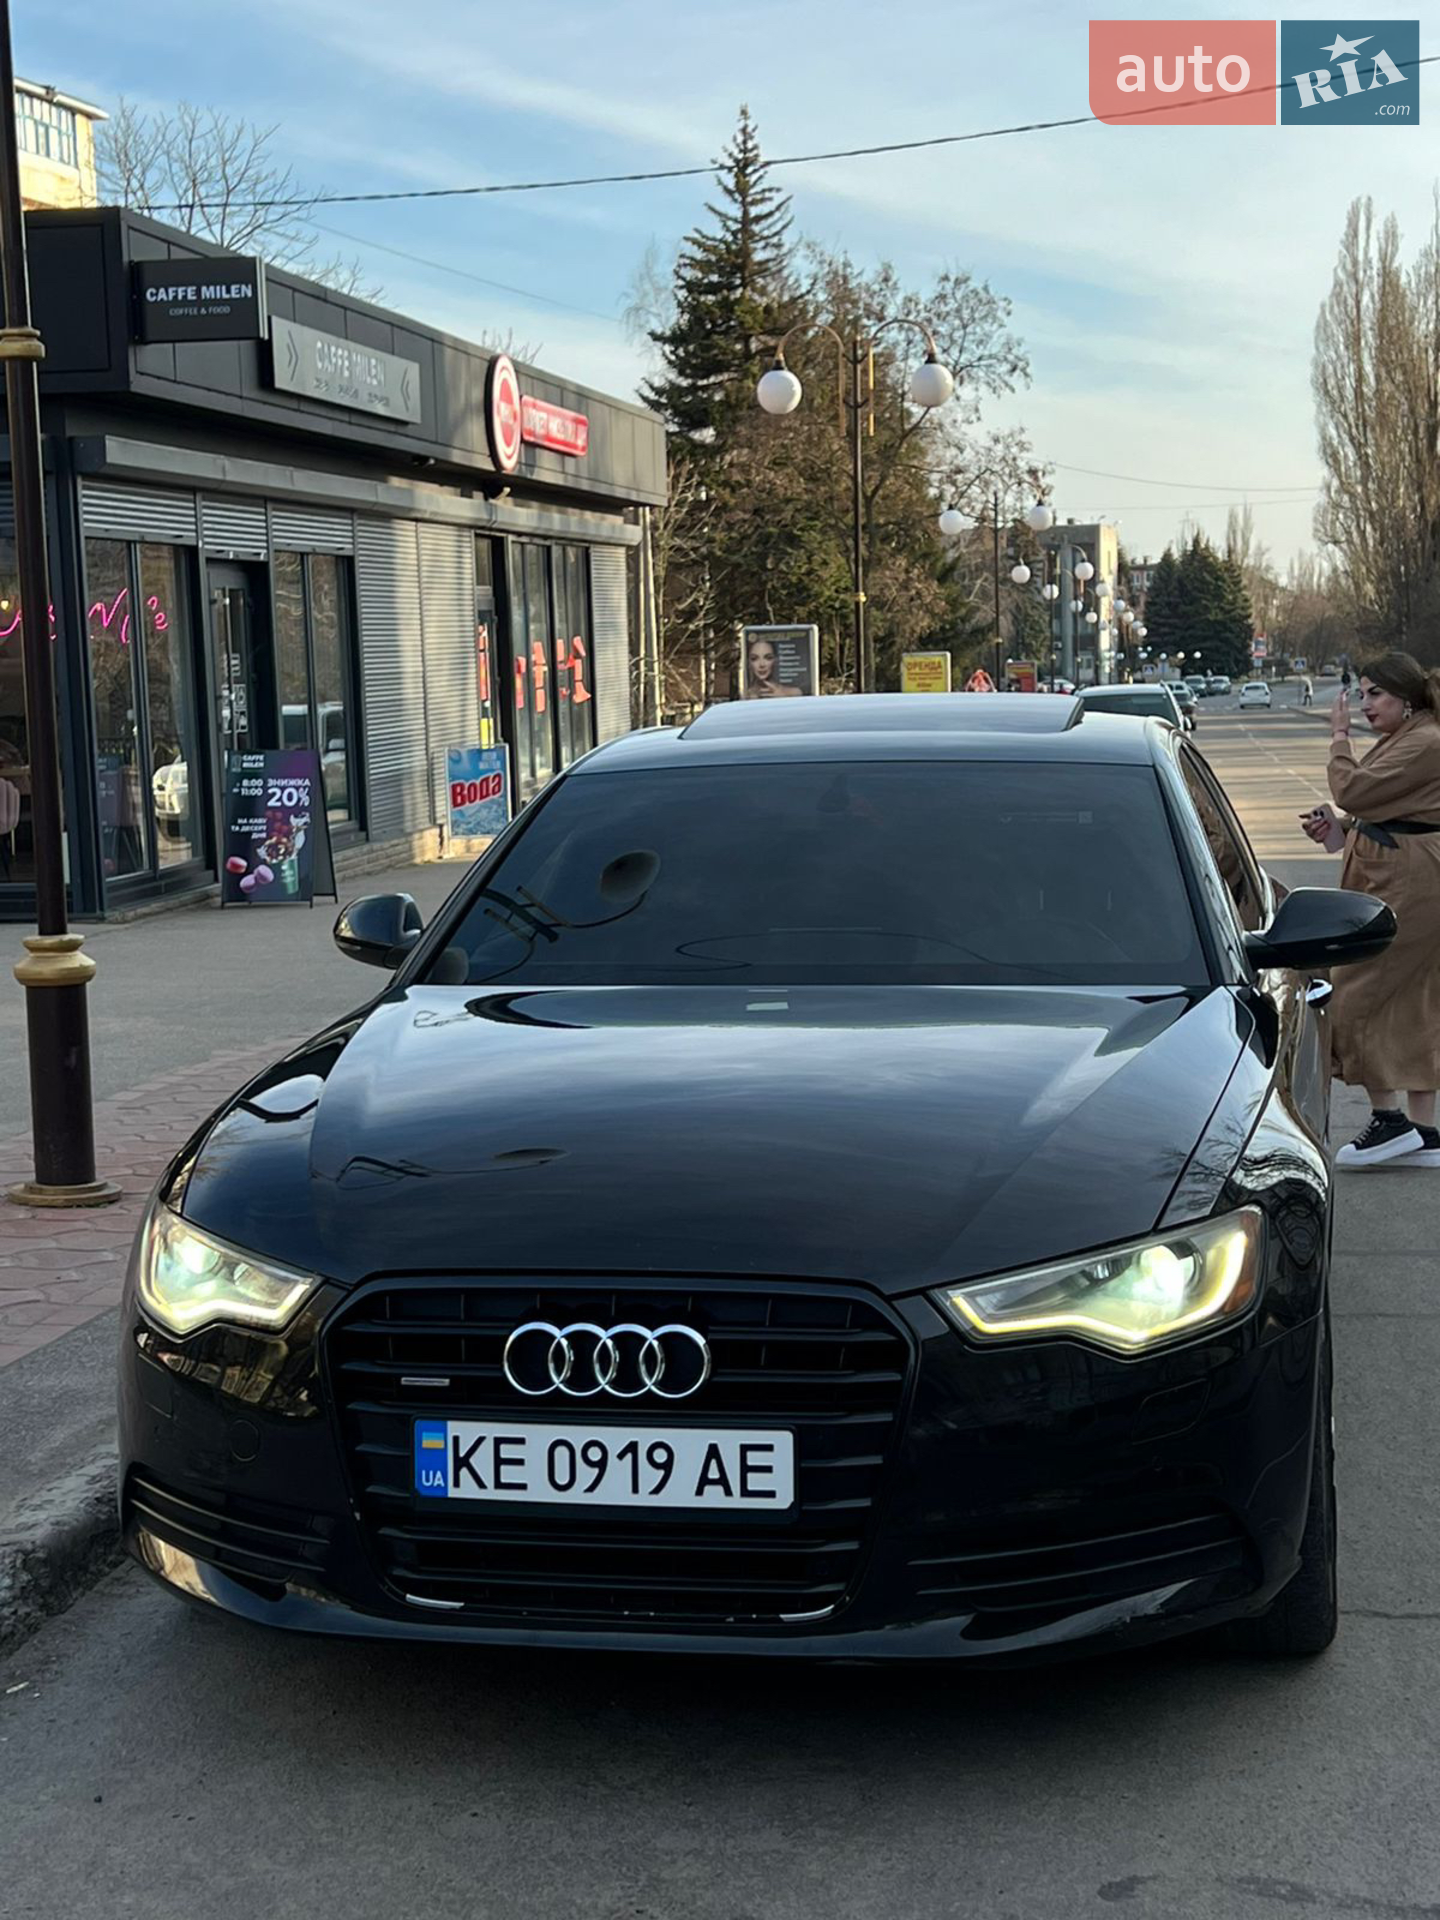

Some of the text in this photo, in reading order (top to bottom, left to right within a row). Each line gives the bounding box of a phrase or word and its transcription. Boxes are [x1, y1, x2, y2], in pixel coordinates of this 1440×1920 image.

[145, 283, 252, 302] CAFFE MILEN
[169, 305, 231, 316] COFFEE & FOOD
[242, 779, 264, 787] 8:00
[267, 778, 311, 787] ЗНИЖКА
[451, 772, 503, 809] Вода
[241, 788, 264, 796] 11:00
[267, 787, 310, 807] 20%
[452, 1434, 777, 1499] KE 0919 AE
[421, 1469, 445, 1487] UA
